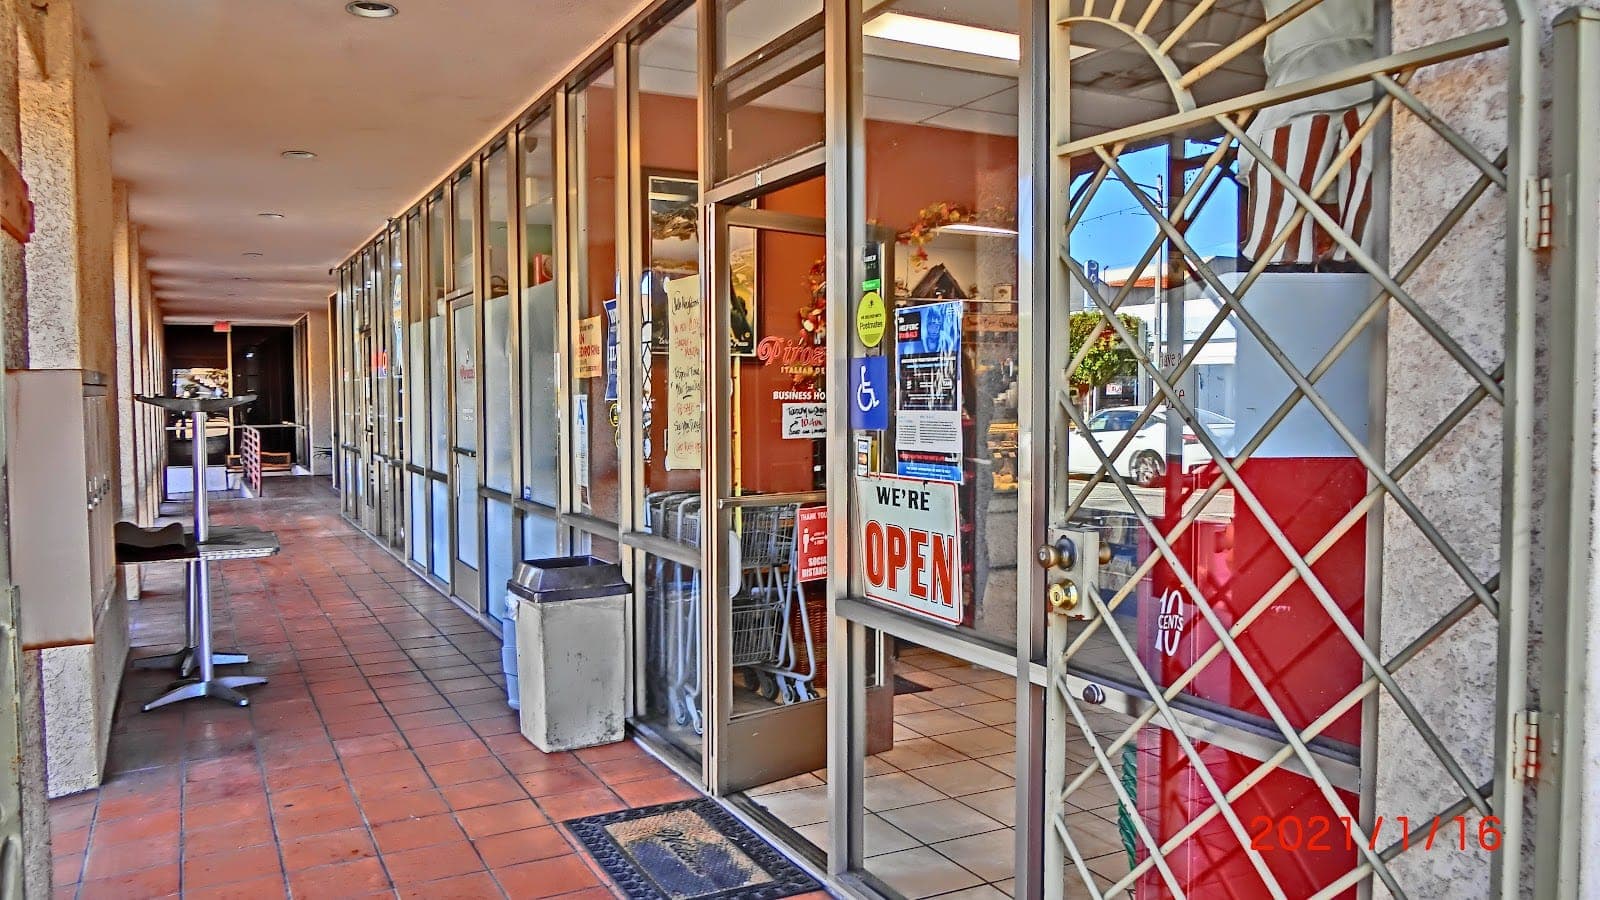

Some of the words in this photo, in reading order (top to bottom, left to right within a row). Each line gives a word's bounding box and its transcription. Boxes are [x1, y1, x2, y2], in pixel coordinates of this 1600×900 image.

[758, 336, 827, 366] Piroz
[814, 367, 826, 375] DE
[772, 391, 812, 400] BUSINESS
[813, 391, 826, 400] HO
[876, 486, 931, 511] WE'RE
[800, 512, 816, 520] THANK
[865, 519, 955, 608] OPEN
[801, 566, 827, 578] DISTANC
[1158, 614, 1184, 631] CENTS
